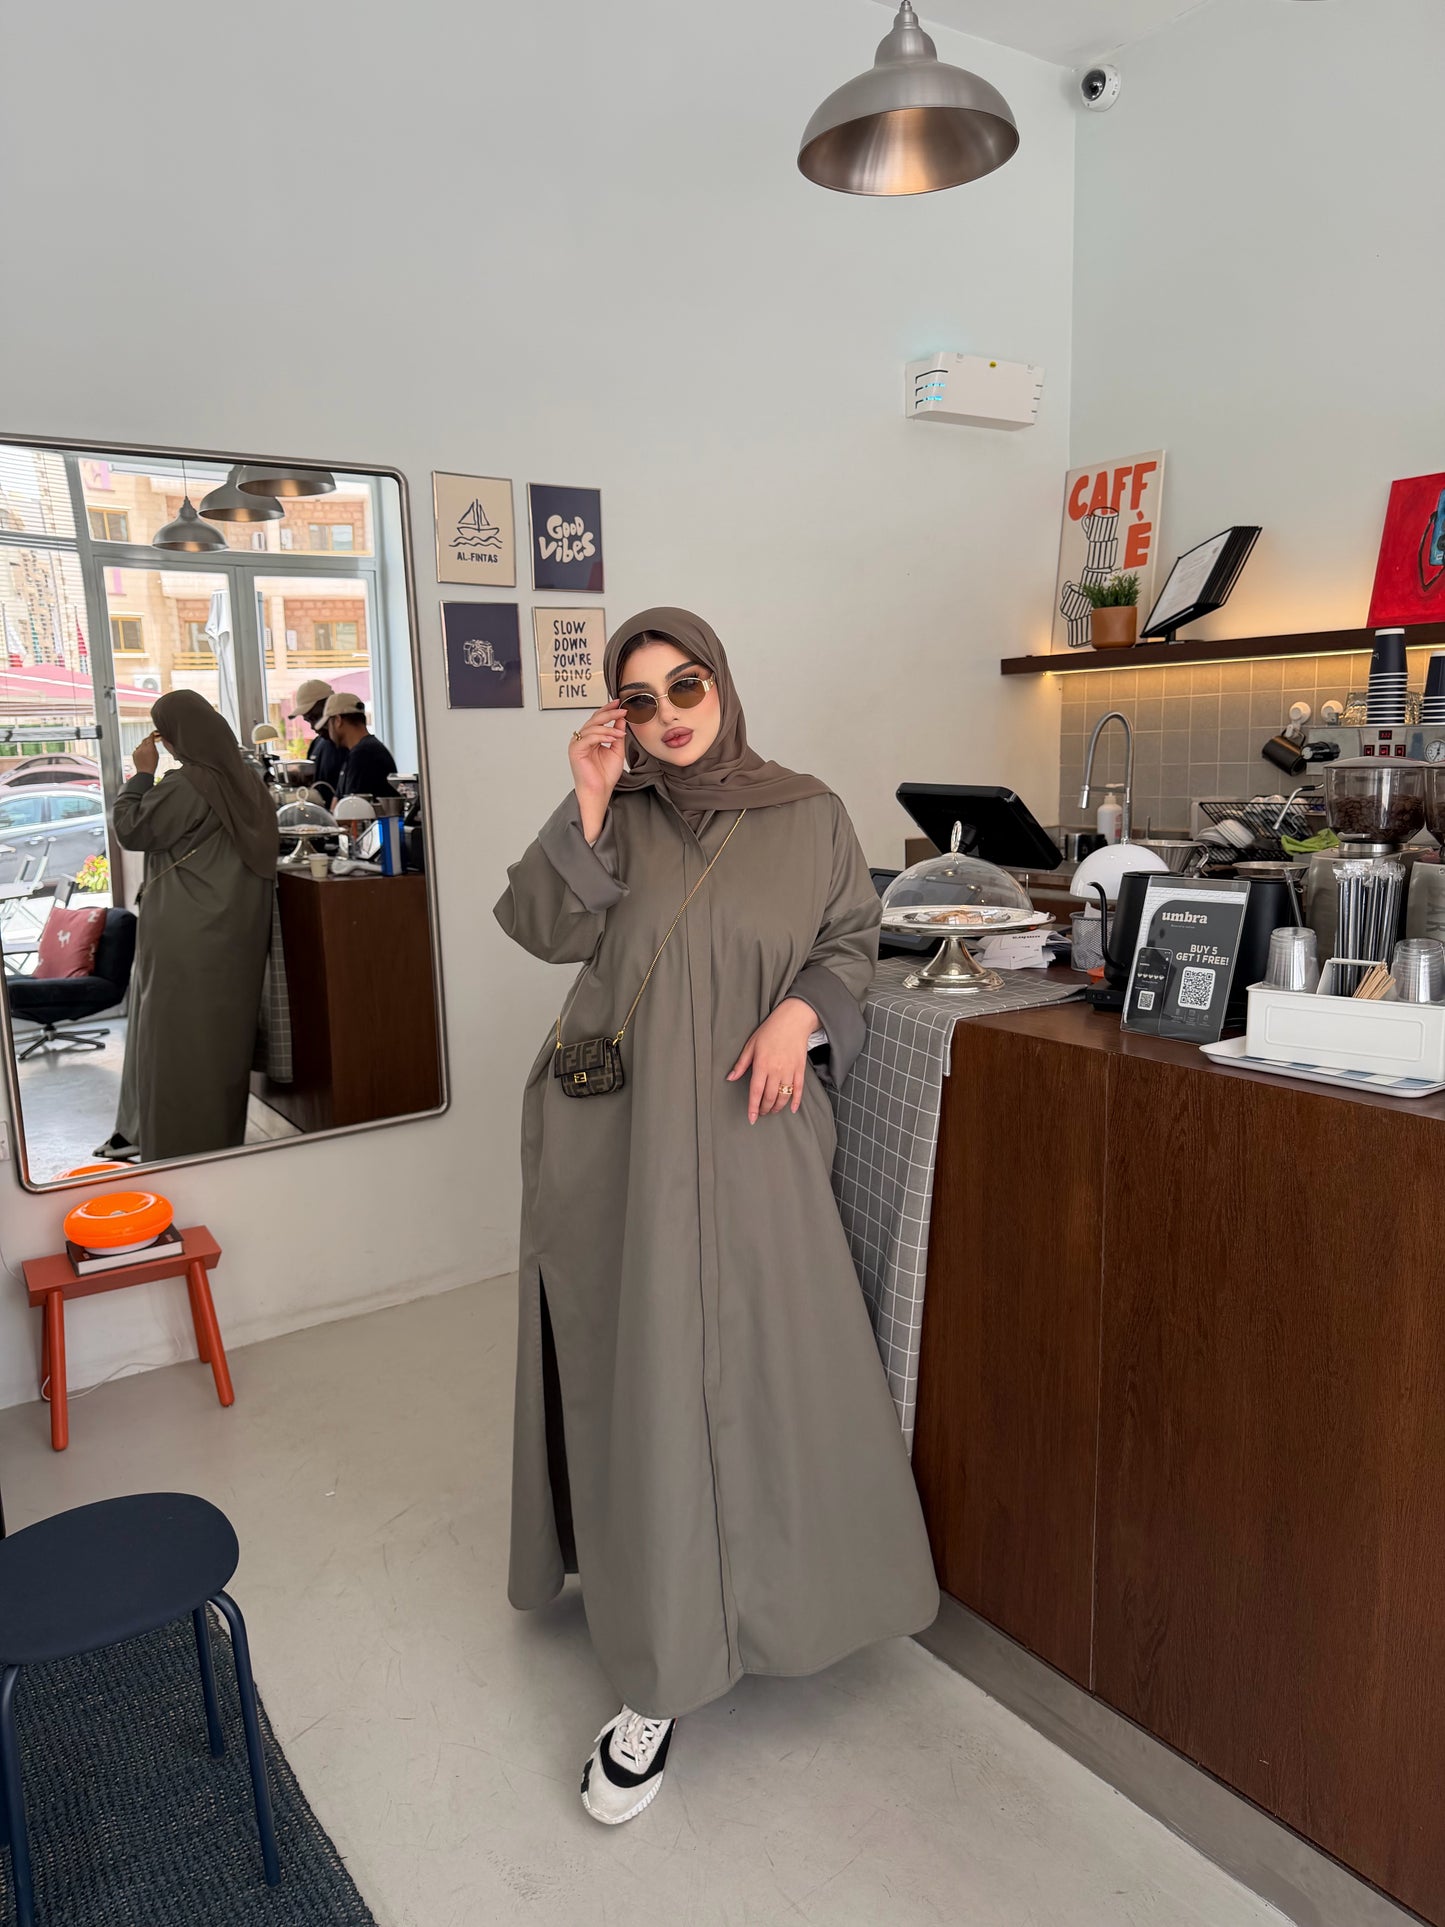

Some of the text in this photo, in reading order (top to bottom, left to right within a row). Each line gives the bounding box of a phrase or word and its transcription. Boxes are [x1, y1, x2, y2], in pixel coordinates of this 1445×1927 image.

[1068, 461, 1157, 521] CAFF
[457, 551, 498, 563] AL-FINTAS
[553, 619, 586, 635] SLOW
[554, 637, 587, 651] DOWN
[553, 653, 592, 668] YOU'RE
[554, 668, 592, 682] DOING
[558, 683, 588, 698] FINE
[1161, 911, 1208, 924] umbra
[1190, 944, 1218, 955] BUY 5
[1175, 951, 1230, 966] GET 1 FREE!
